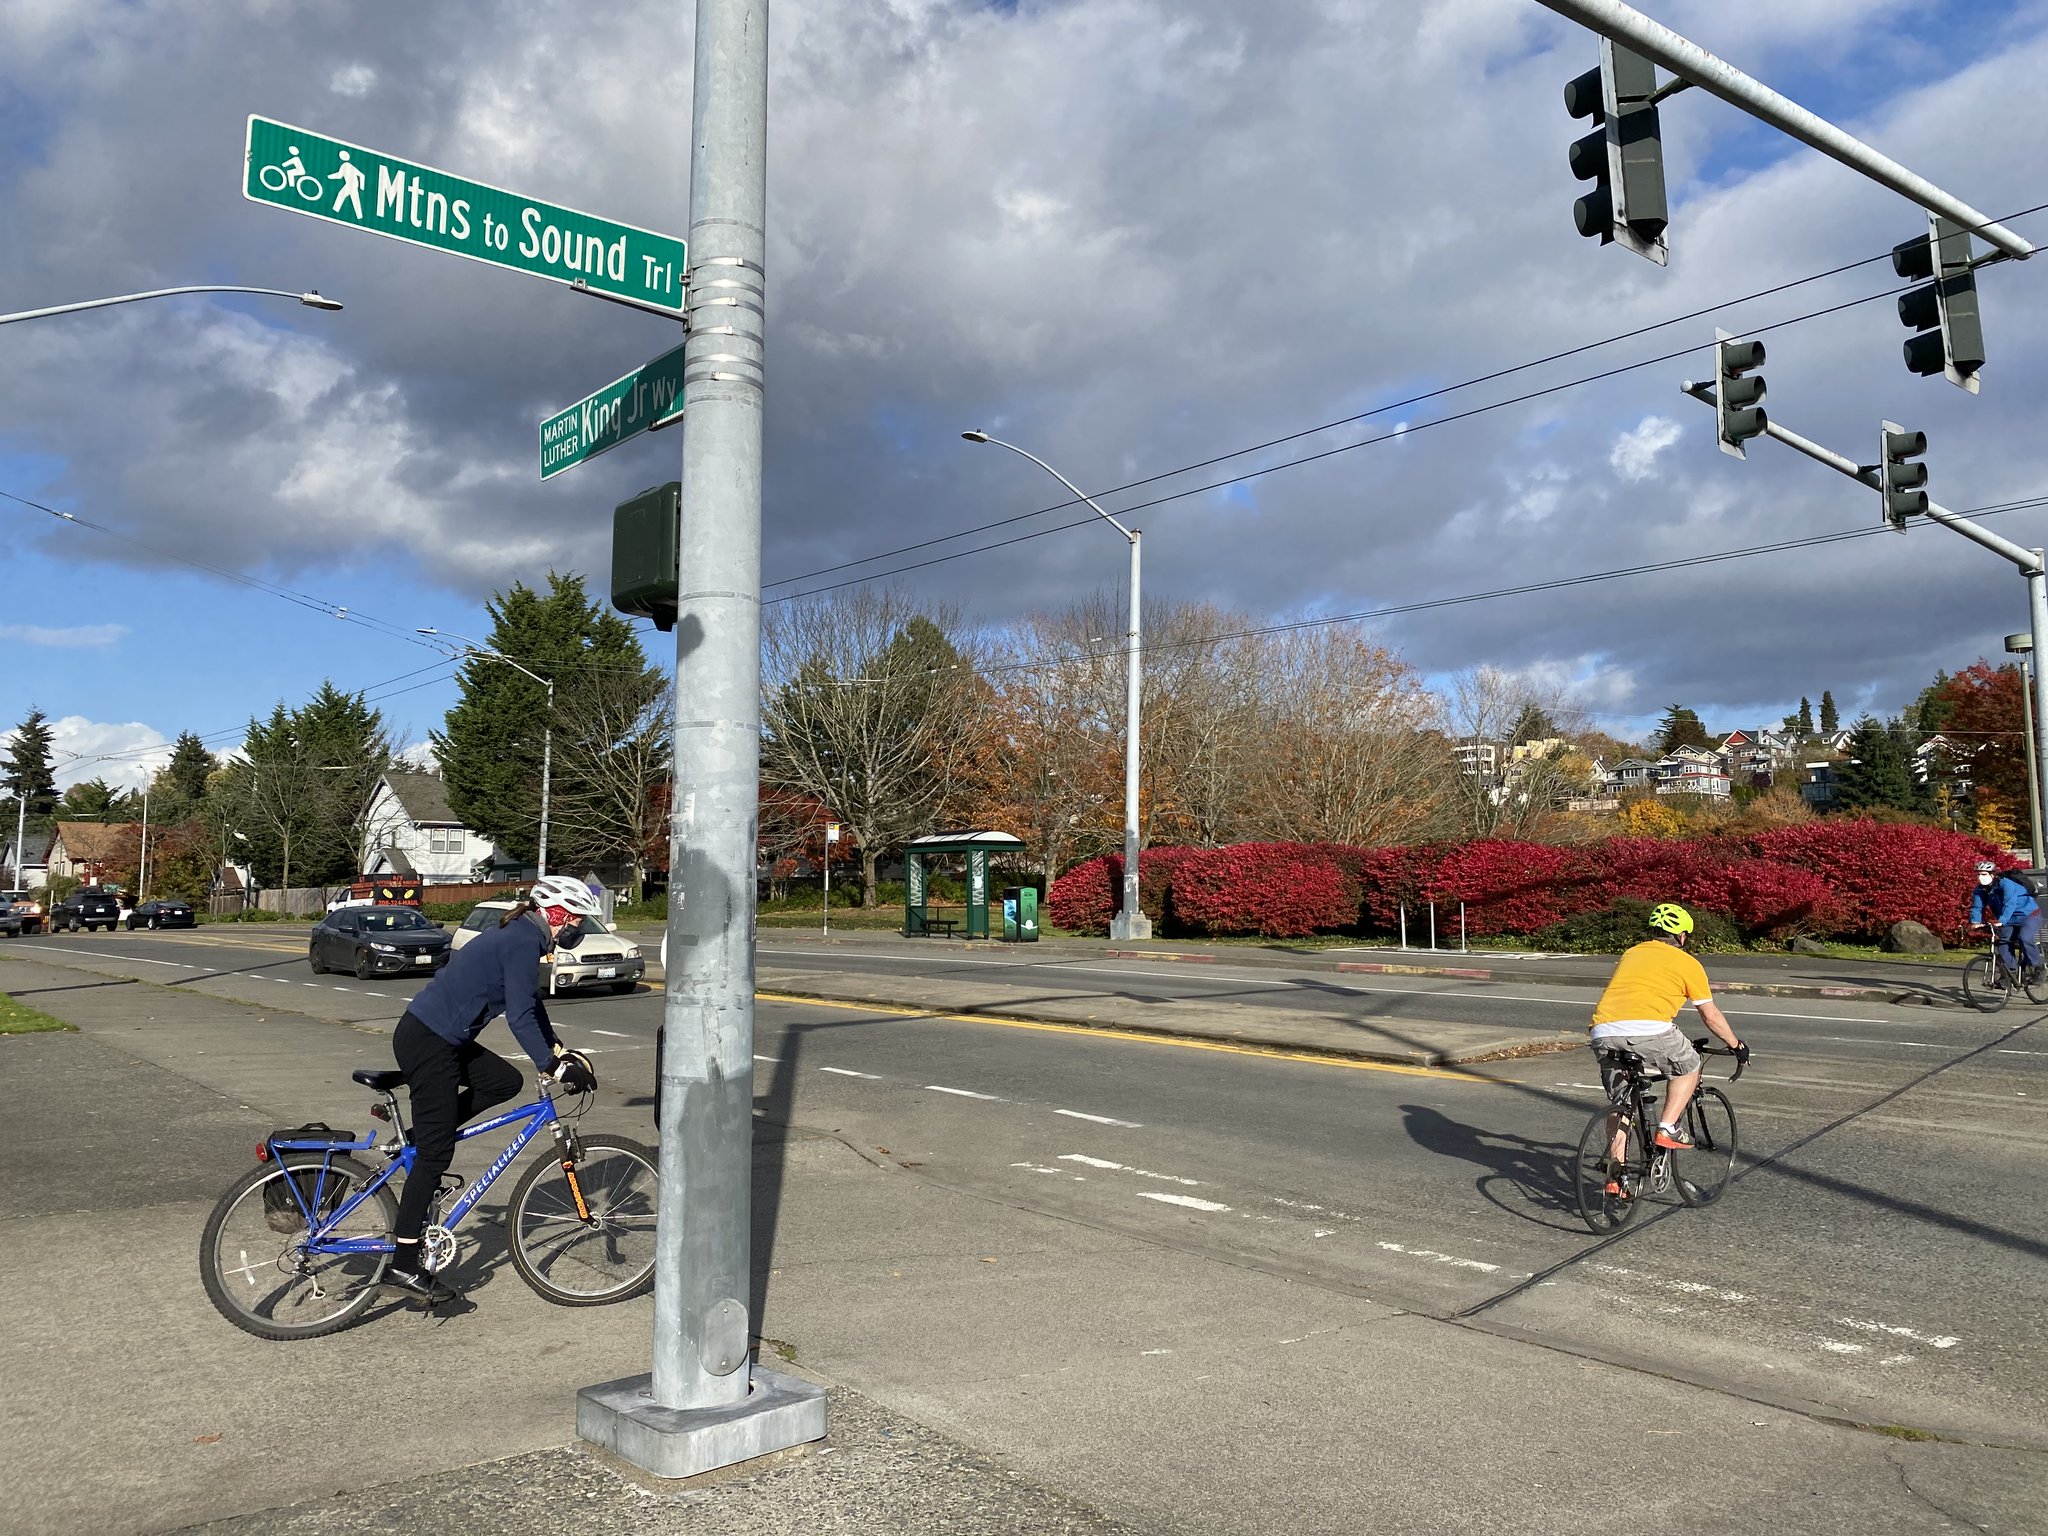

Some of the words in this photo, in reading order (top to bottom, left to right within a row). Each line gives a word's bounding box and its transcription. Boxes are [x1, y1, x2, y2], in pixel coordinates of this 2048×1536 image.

[376, 165, 471, 240] Mtns
[483, 213, 509, 250] to
[519, 207, 627, 282] Sound
[642, 254, 671, 294] Trl
[544, 412, 578, 445] MARTIN
[581, 397, 621, 447] King
[627, 377, 648, 424] Jr
[652, 376, 676, 411] Wy
[544, 435, 578, 467] LUTHER
[464, 1133, 526, 1208] SPECIALIZED
